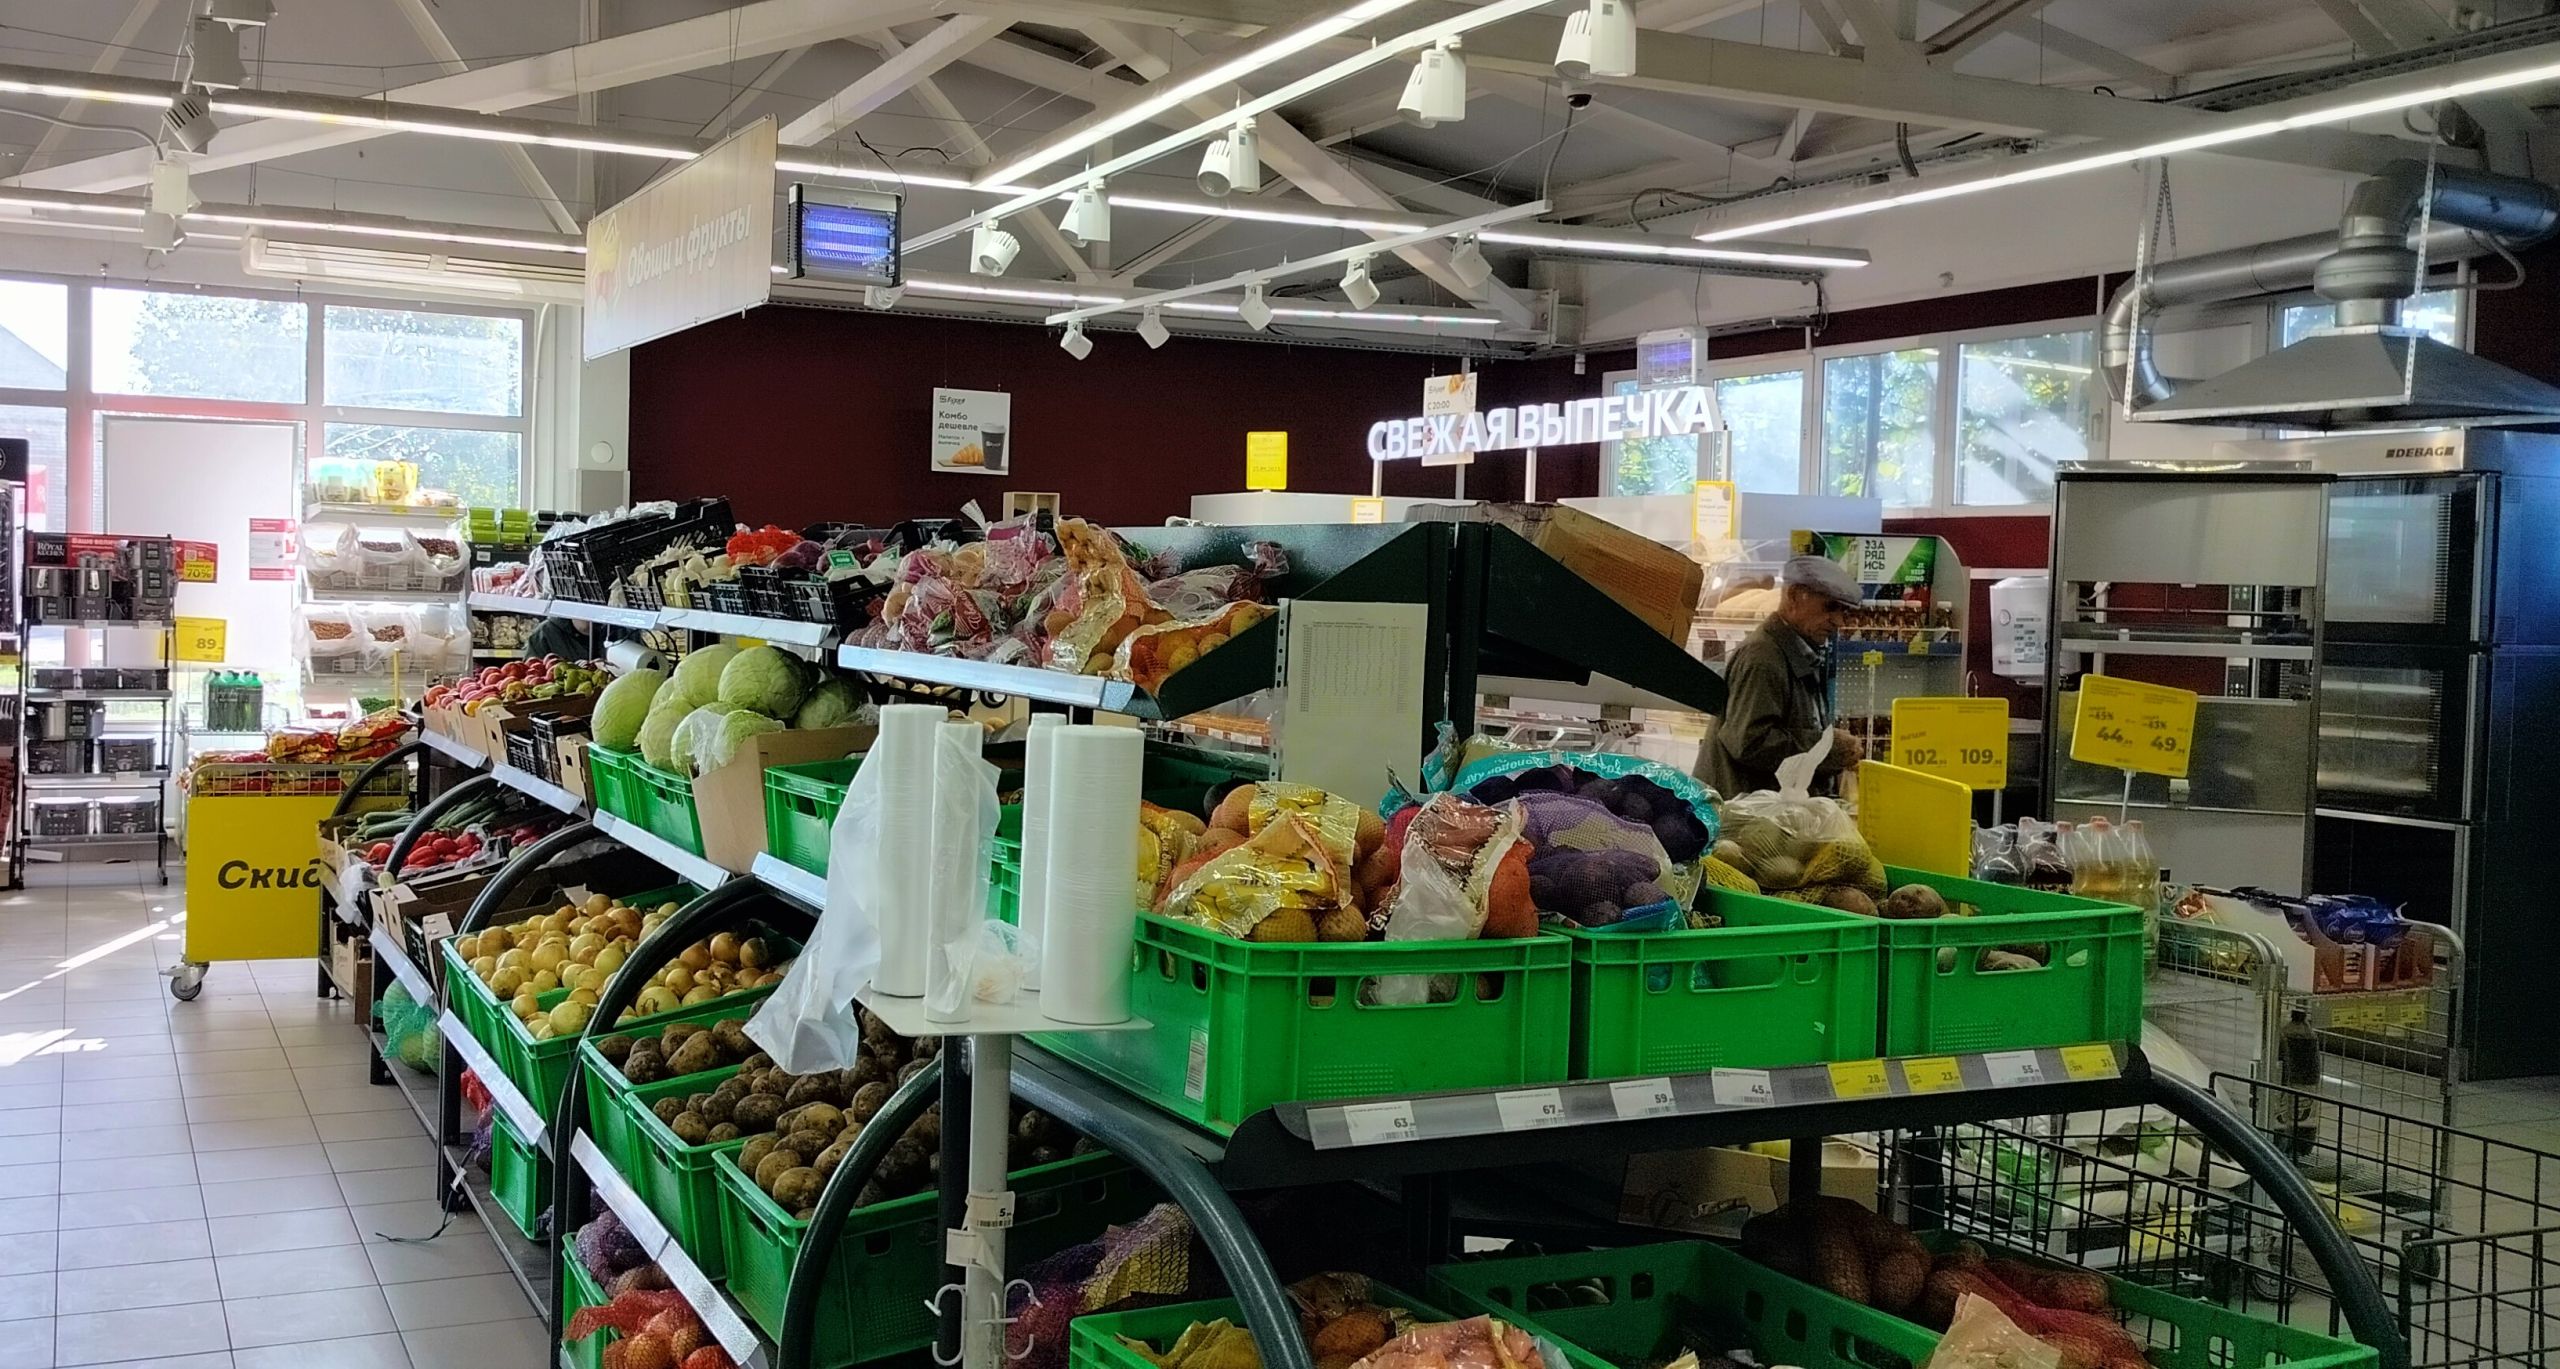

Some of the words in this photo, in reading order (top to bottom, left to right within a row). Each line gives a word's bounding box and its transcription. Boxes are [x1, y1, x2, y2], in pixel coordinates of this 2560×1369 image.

[627, 241, 673, 288] Овощи
[675, 235, 685, 267] и
[686, 204, 752, 275] фрукты
[938, 410, 968, 421] Комбо
[938, 422, 979, 431] дешевле
[1367, 408, 1510, 461] СВЕЖАЯ
[1518, 386, 1717, 449] ВЫПЕЧКА
[2395, 446, 2445, 458] DEBAG
[1864, 550, 1885, 560] РЯД
[1864, 560, 1885, 570] ИСЬ
[186, 568, 212, 579] 70%
[196, 638, 217, 650] 89
[1905, 749, 1938, 766] 102
[1960, 748, 1994, 764] 109
[1867, 1075, 1881, 1084] 28
[1941, 1072, 1953, 1081] 23
[1751, 1085, 1765, 1095] 45
[1654, 1094, 1668, 1104] 59
[1542, 1104, 1556, 1115] 67
[1394, 1118, 1408, 1128] 63
